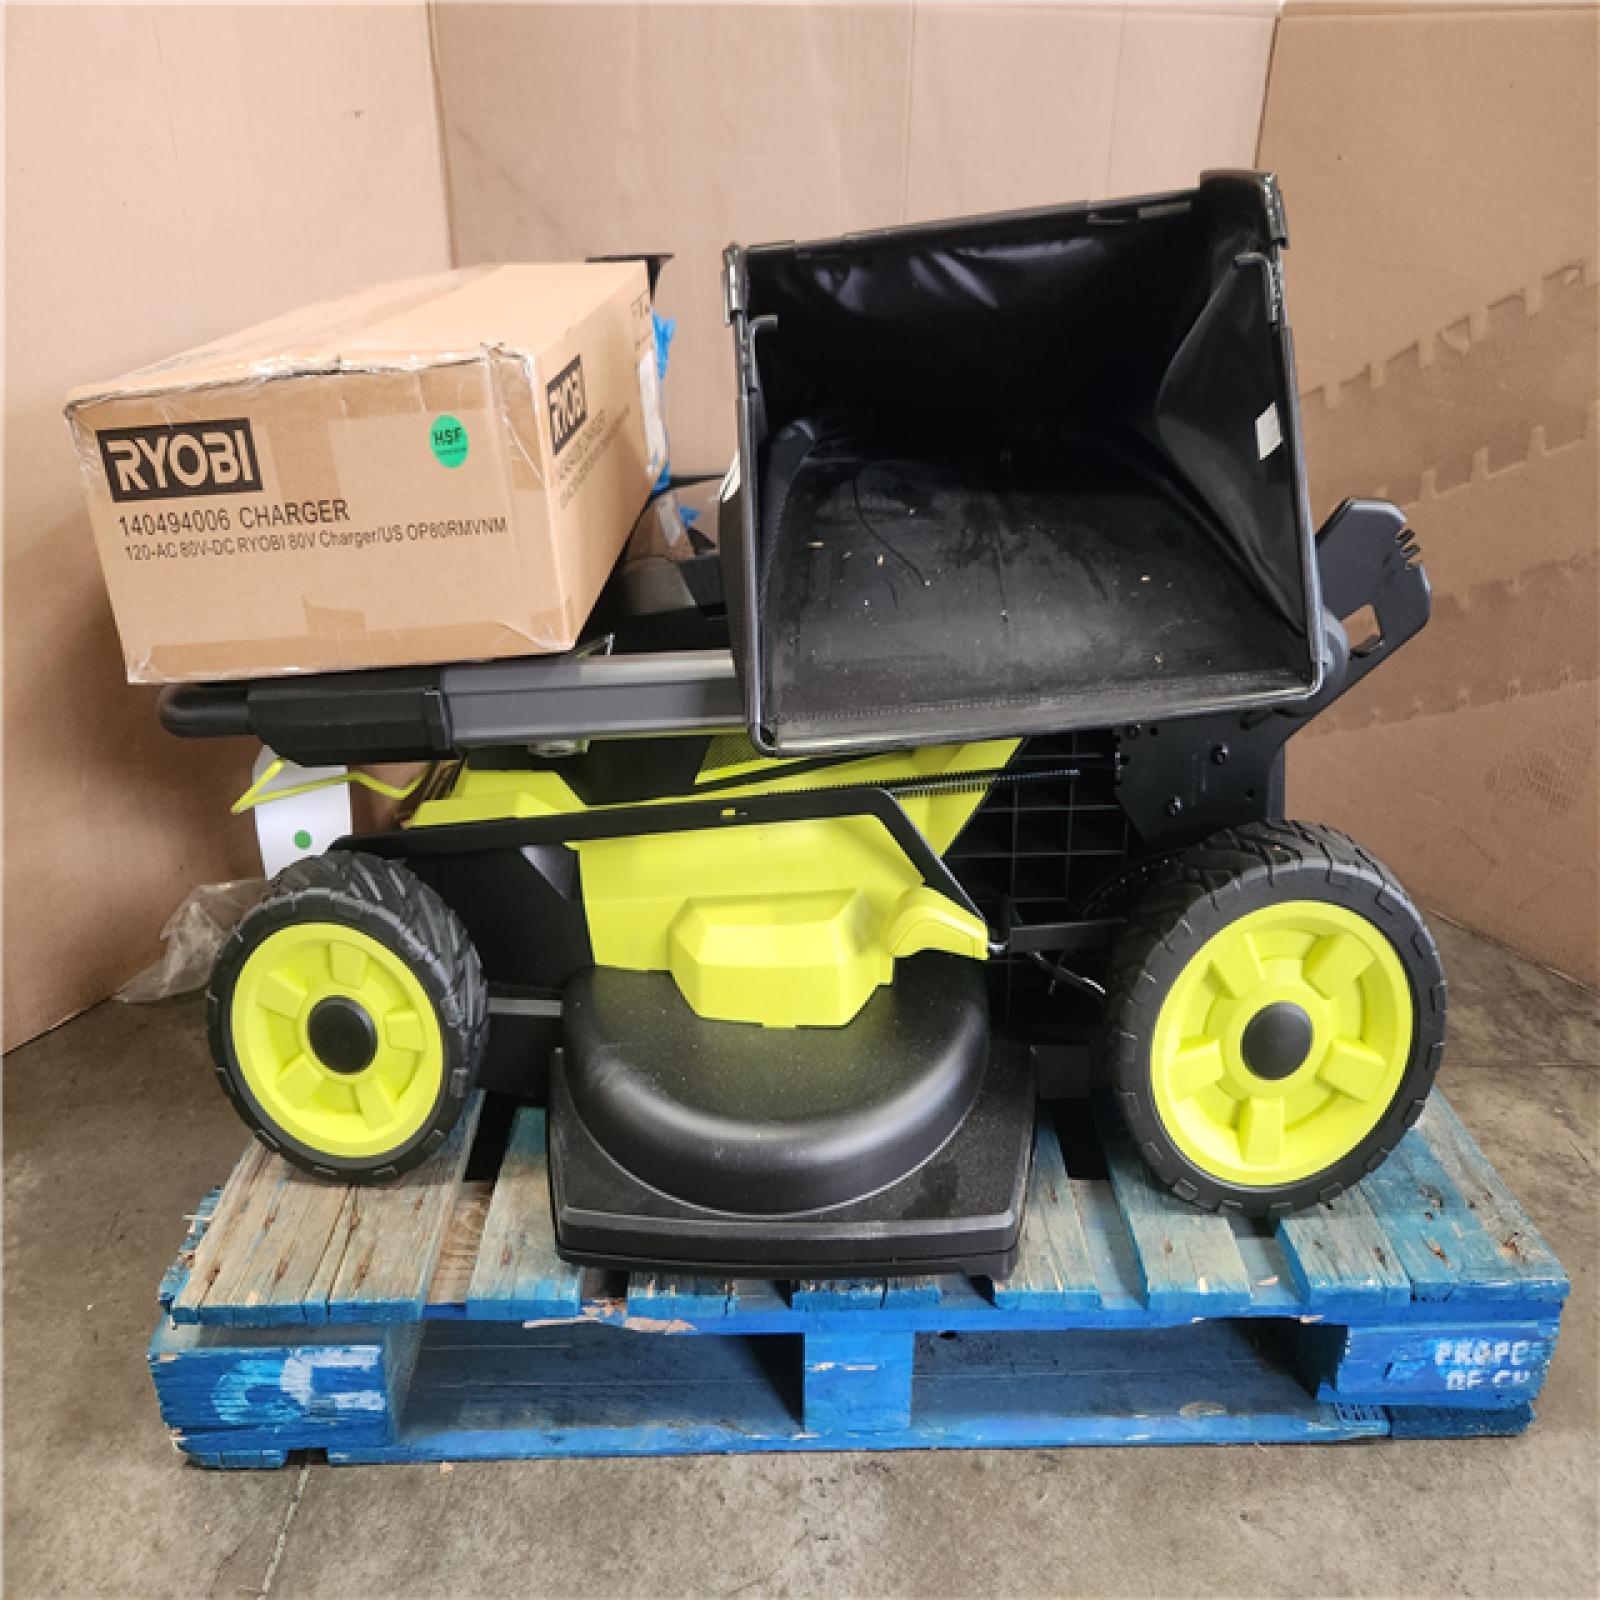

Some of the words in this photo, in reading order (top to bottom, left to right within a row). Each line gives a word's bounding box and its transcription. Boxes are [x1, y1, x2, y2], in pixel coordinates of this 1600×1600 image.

[106, 429, 254, 492] RYOBI
[119, 507, 231, 537] 140494006
[239, 499, 351, 528] CHARGER
[125, 542, 177, 561] 120-AC
[238, 534, 286, 554] RYOBI
